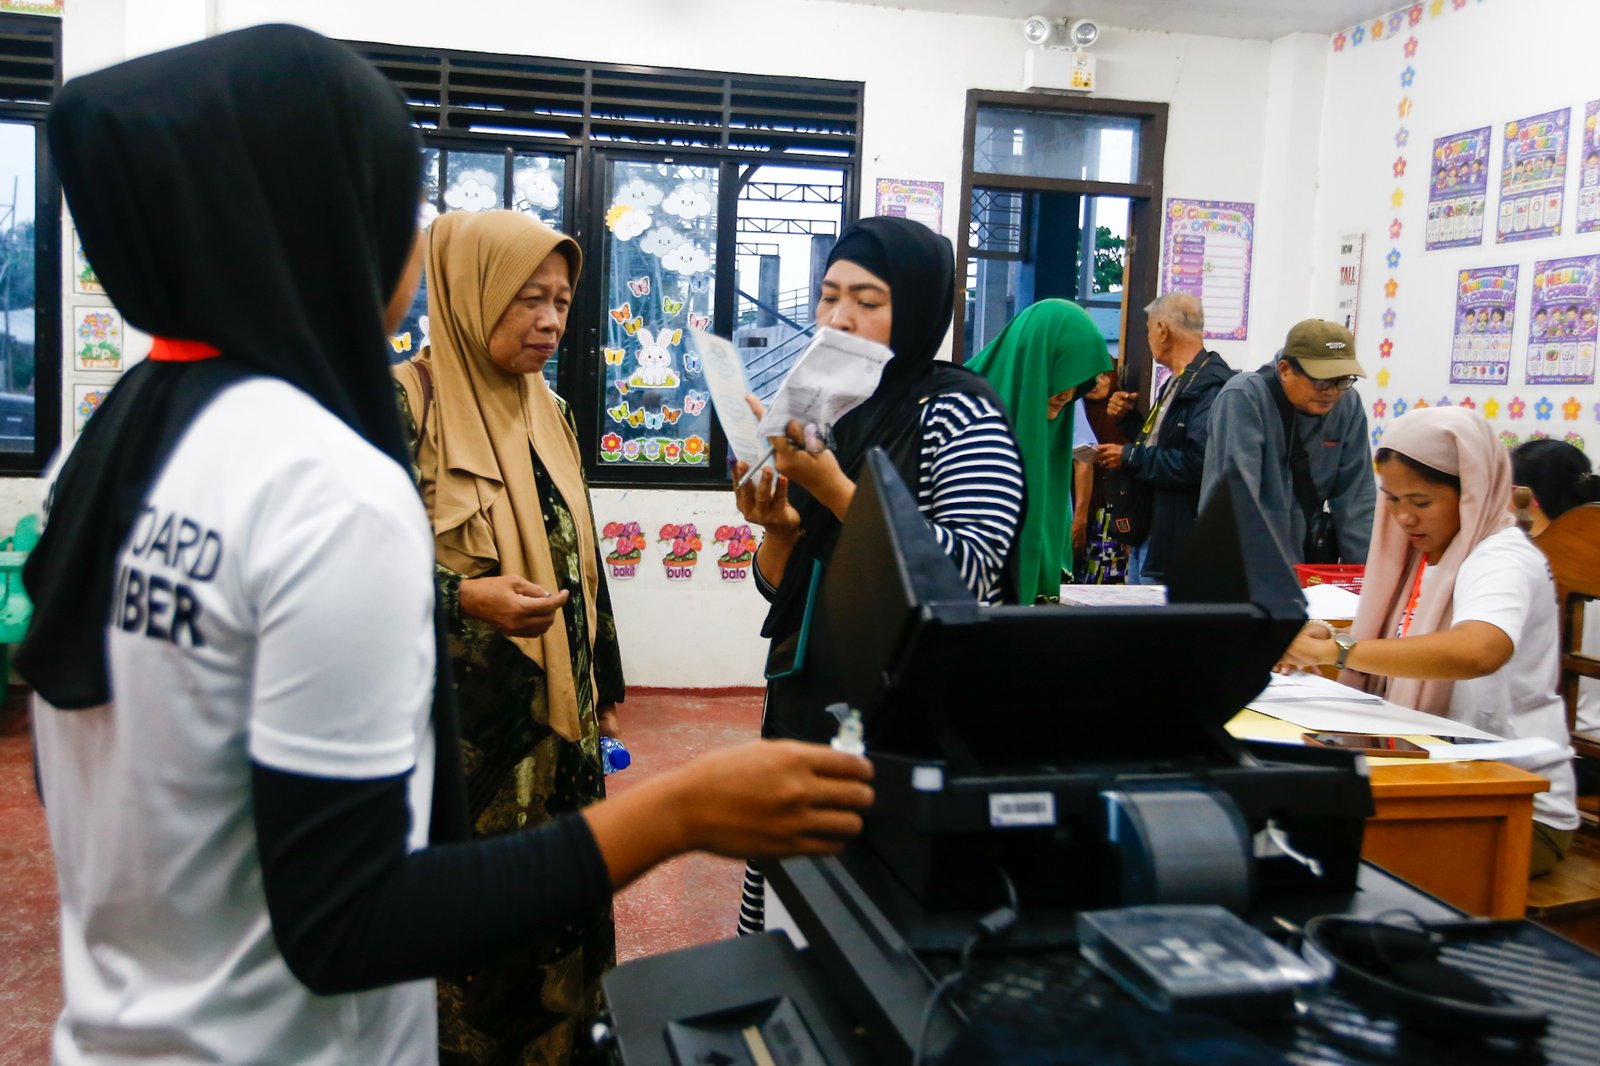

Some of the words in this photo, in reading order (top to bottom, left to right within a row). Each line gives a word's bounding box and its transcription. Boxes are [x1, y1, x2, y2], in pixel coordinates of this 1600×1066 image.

[1187, 207, 1242, 222] Classroom
[1190, 220, 1238, 234] Officers
[1340, 266, 1355, 285] TALL
[1545, 269, 1593, 287] HEALTH
[613, 566, 636, 577] bakit
[666, 567, 692, 578] buto
[721, 568, 747, 579] bato
